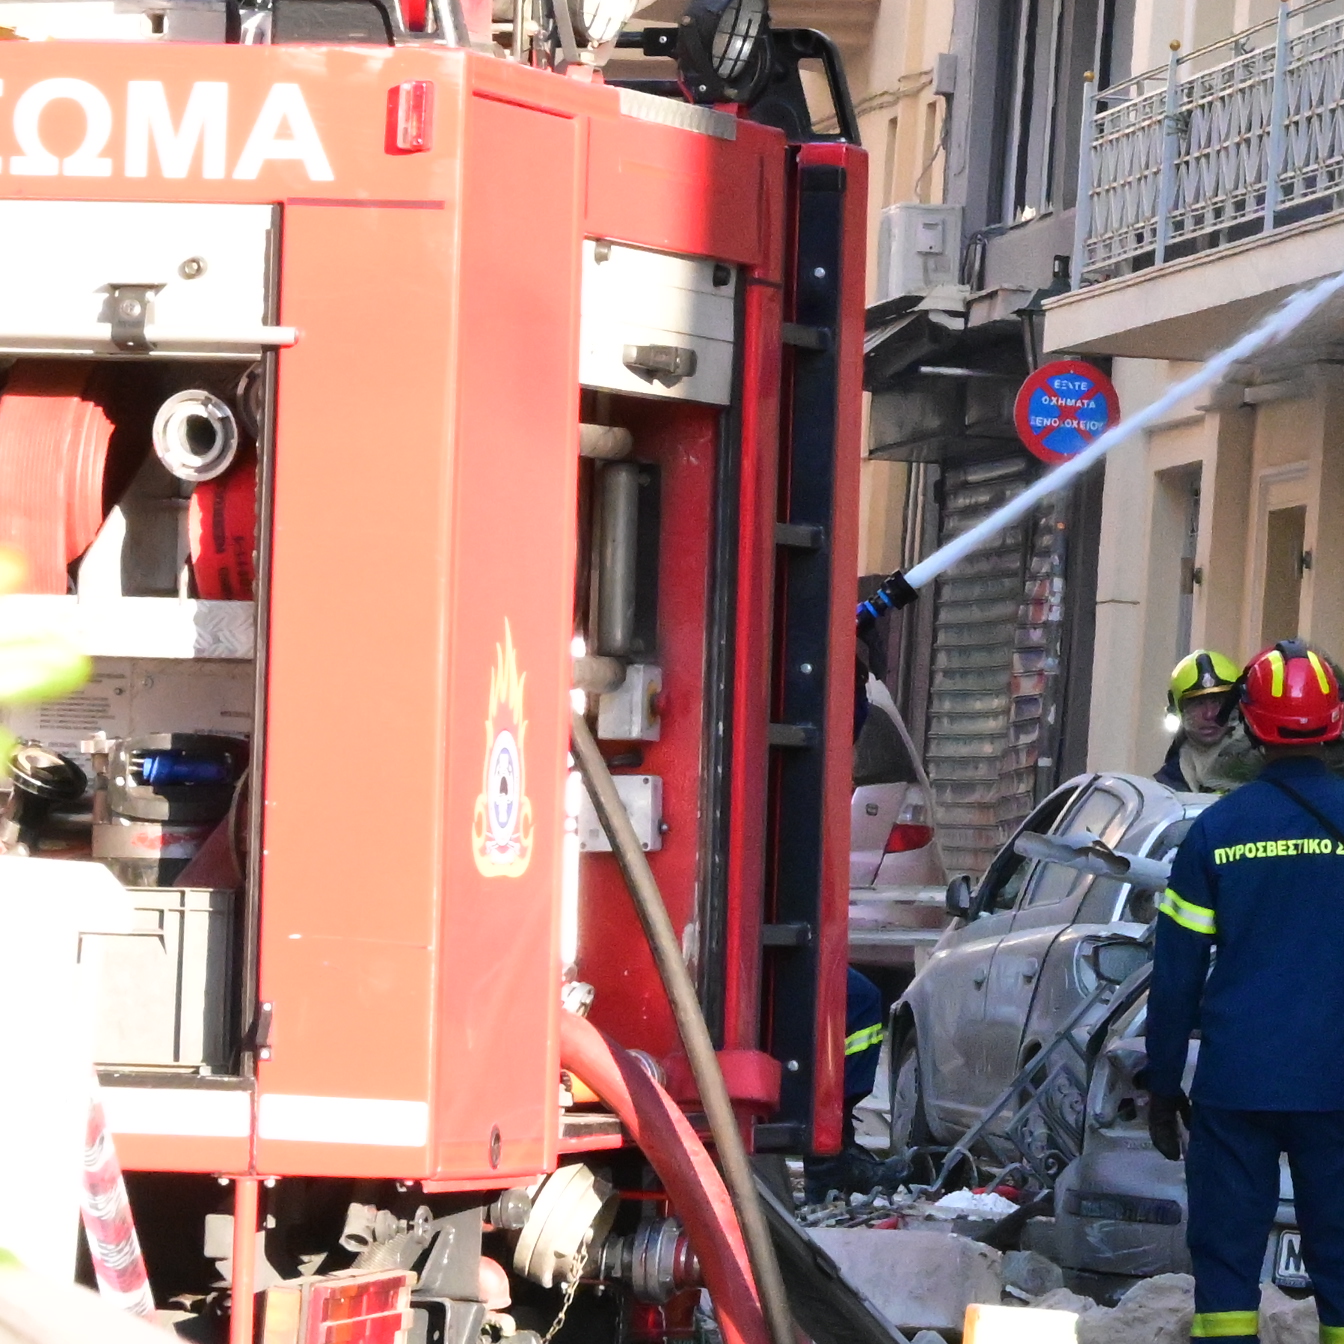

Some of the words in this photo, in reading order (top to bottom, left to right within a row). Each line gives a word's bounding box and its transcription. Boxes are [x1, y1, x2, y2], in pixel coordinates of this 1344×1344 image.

[0, 77, 335, 181] ΩΜΑ
[1041, 395, 1096, 409] ΟΧΗΜΑΤΑ
[1214, 838, 1332, 865] ΠΥΡΟΣΒΕΣΤΙΚΟ
